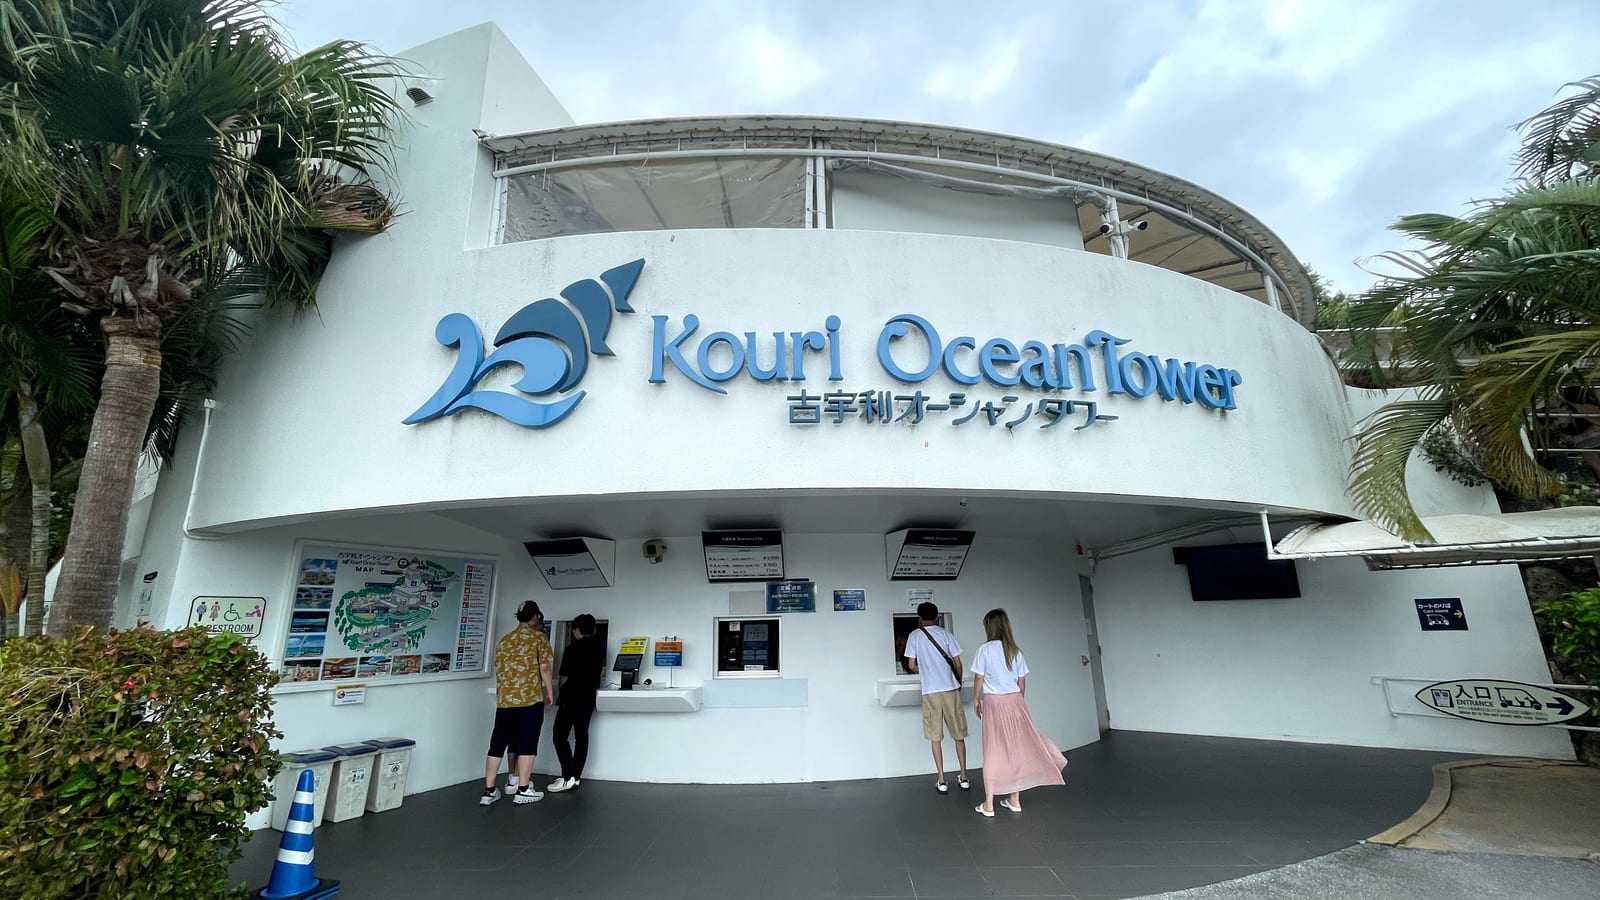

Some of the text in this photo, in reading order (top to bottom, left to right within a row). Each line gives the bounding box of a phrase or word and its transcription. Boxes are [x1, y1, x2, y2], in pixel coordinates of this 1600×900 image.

[648, 313, 1242, 411] Kouri Ocean Tower
[786, 389, 1120, 432] 古宇利オーシャンタワー
[1455, 685, 1491, 699] 入口
[1456, 699, 1494, 707] ENTRANCE
